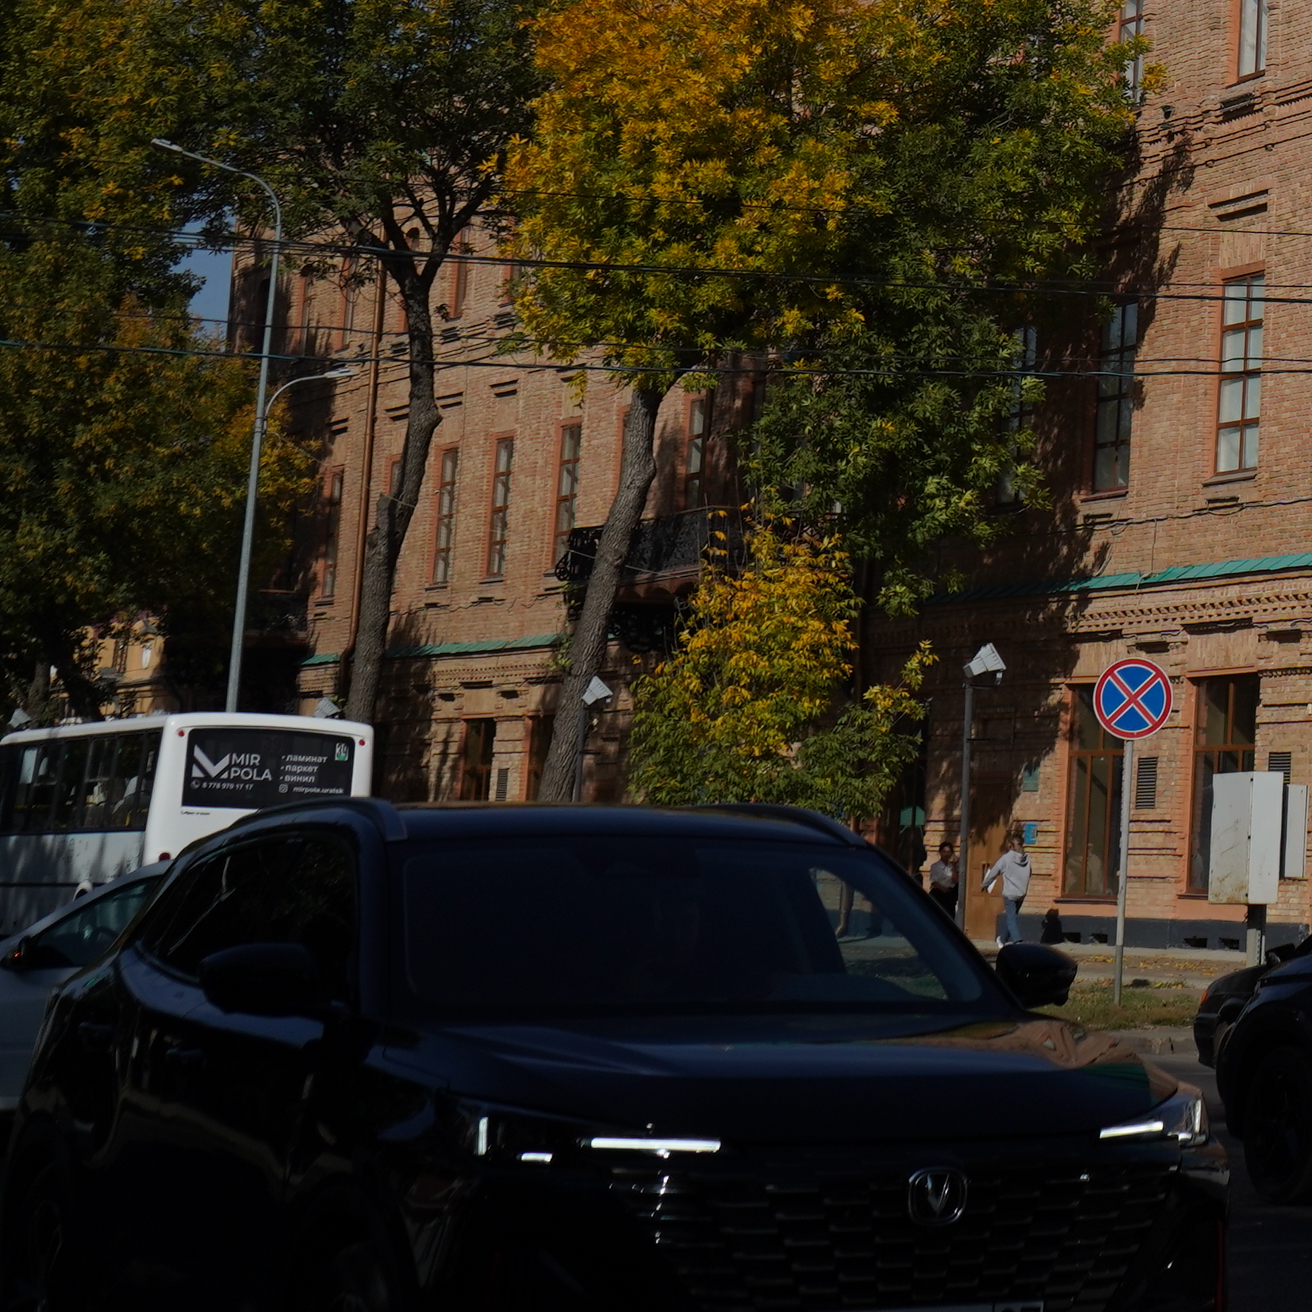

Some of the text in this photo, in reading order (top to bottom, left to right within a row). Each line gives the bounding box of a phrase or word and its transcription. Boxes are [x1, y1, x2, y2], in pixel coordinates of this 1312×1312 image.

[231, 752, 261, 766] MIR
[286, 754, 328, 764] ламинат
[230, 767, 272, 781] POLA
[285, 764, 319, 774] паркет
[284, 774, 316, 783] винил
